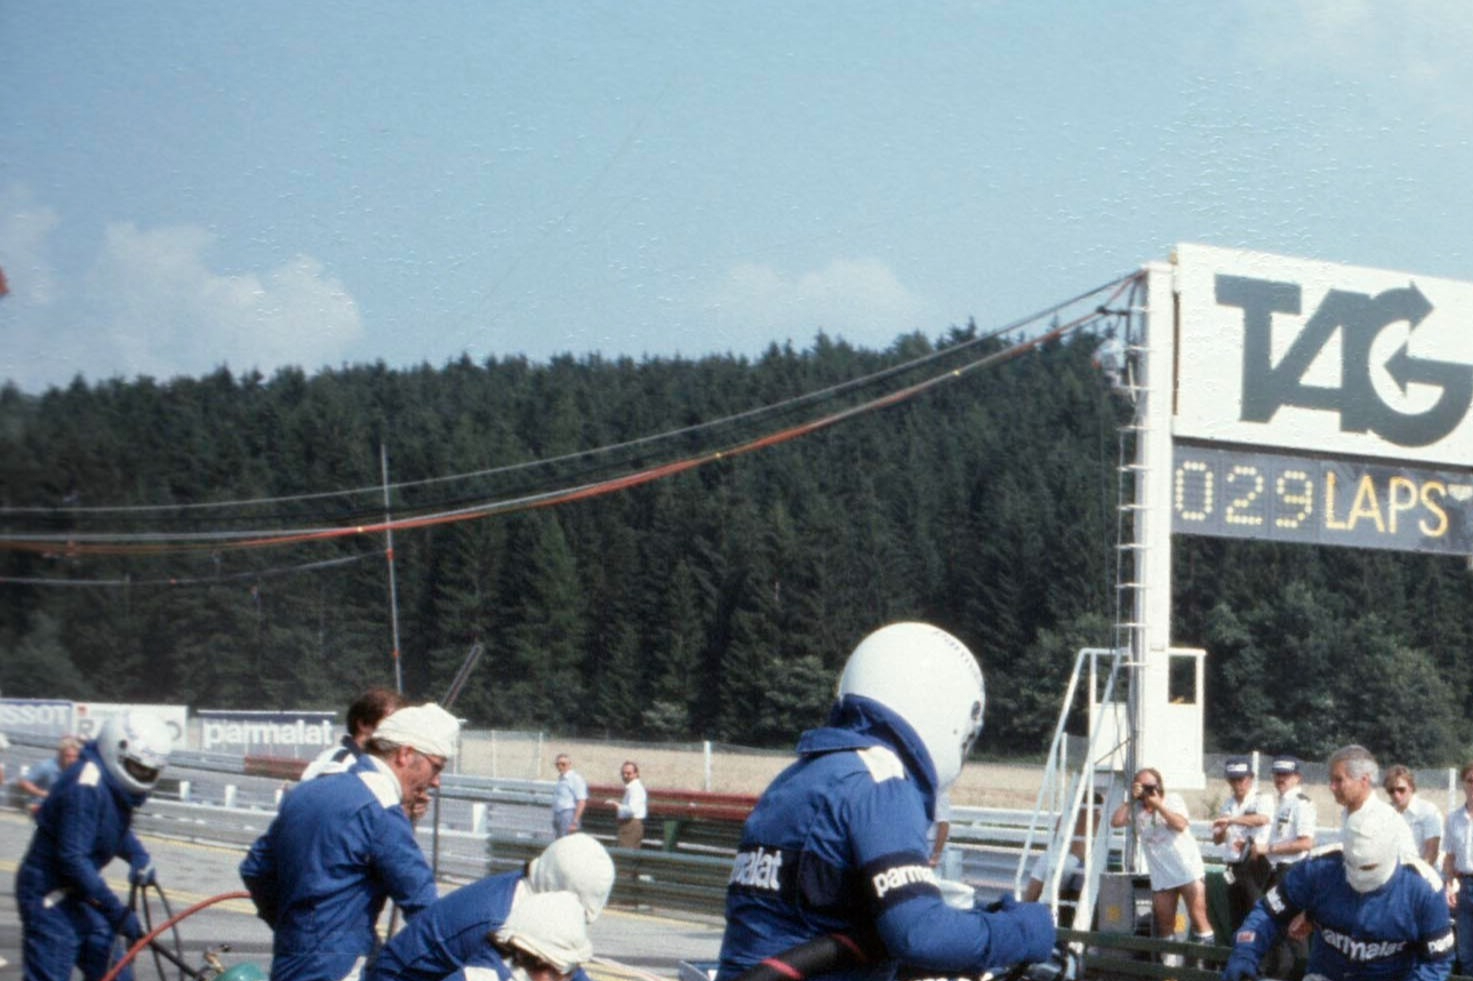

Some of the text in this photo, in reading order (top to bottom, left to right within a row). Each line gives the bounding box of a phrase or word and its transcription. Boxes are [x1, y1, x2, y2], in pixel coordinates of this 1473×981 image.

[1174, 460, 1450, 538] 029 LAPS
[202, 720, 334, 748] parmalat
